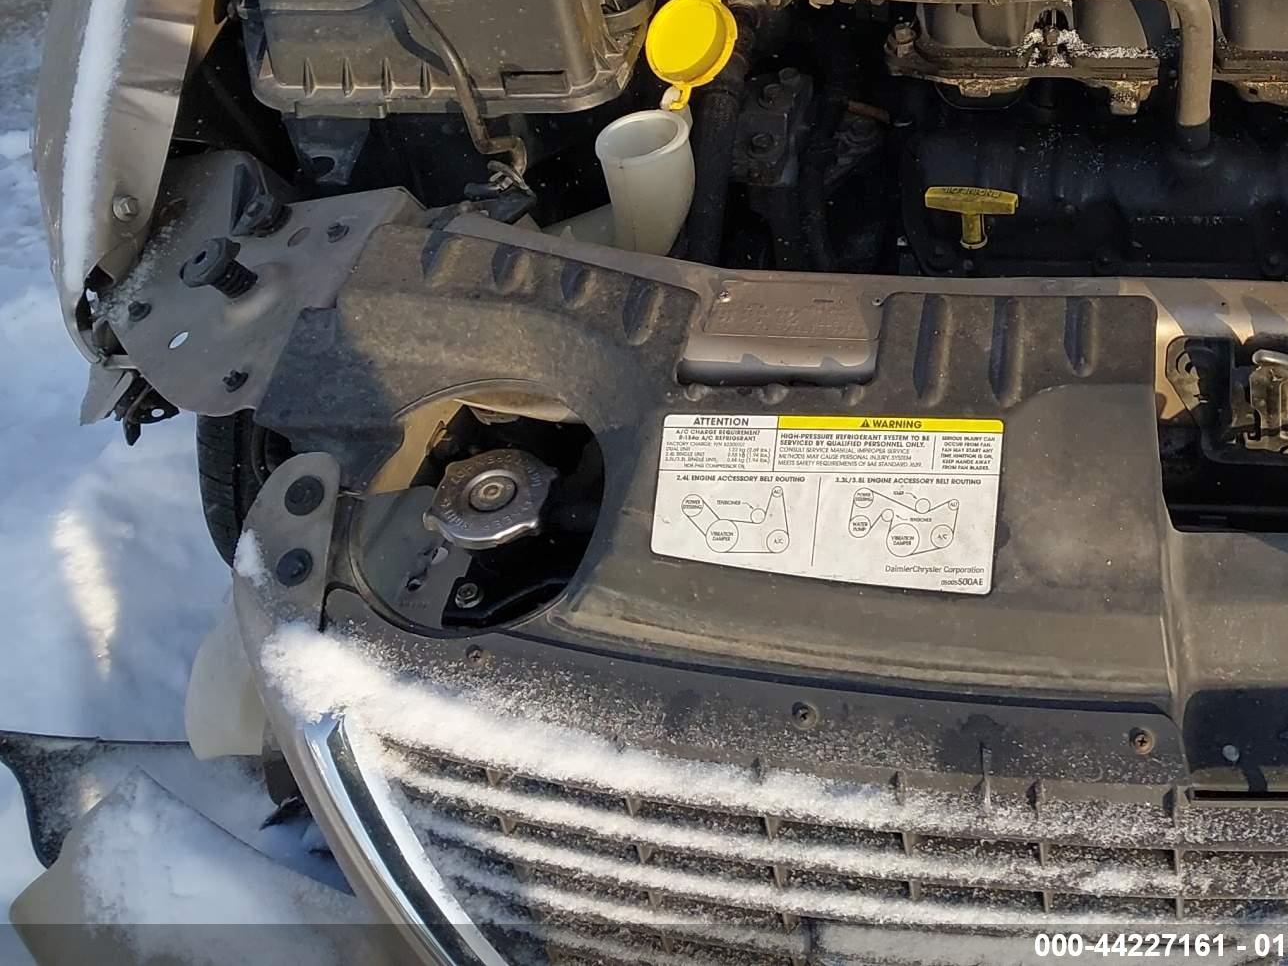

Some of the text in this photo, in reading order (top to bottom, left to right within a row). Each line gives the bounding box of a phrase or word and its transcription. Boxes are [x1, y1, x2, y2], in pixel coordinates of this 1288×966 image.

[693, 417, 749, 426] ATTENTION
[872, 419, 922, 429] WARNING
[835, 433, 882, 441] REFRIGERANT
[892, 477, 934, 485] ACCESSORY
[884, 565, 985, 574] DaimlerChrysler Corporation
